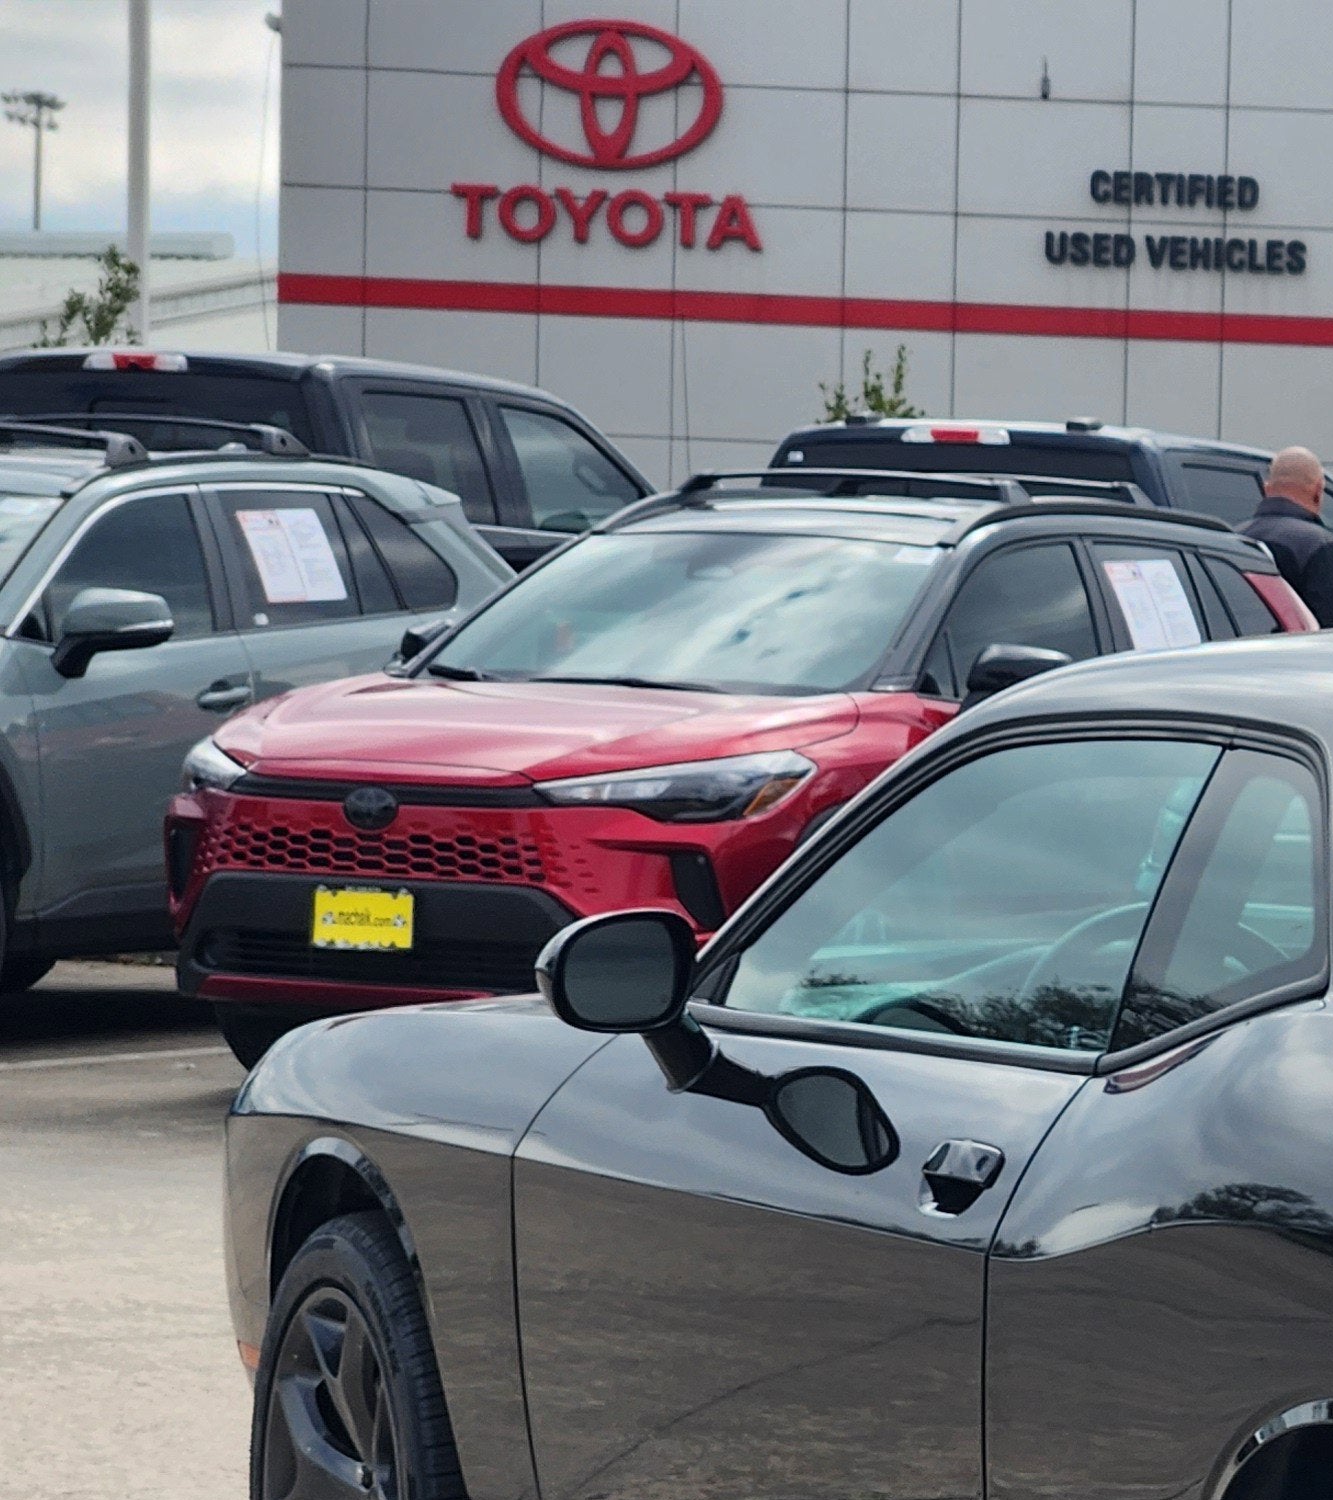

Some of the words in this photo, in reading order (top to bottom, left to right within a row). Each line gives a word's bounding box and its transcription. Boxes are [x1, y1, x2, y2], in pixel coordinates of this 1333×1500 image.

[1089, 169, 1260, 211] CERTIFIED
[450, 182, 763, 252] TOYOTA
[1044, 230, 1137, 268] USED
[1144, 234, 1308, 275] VEHICLES
